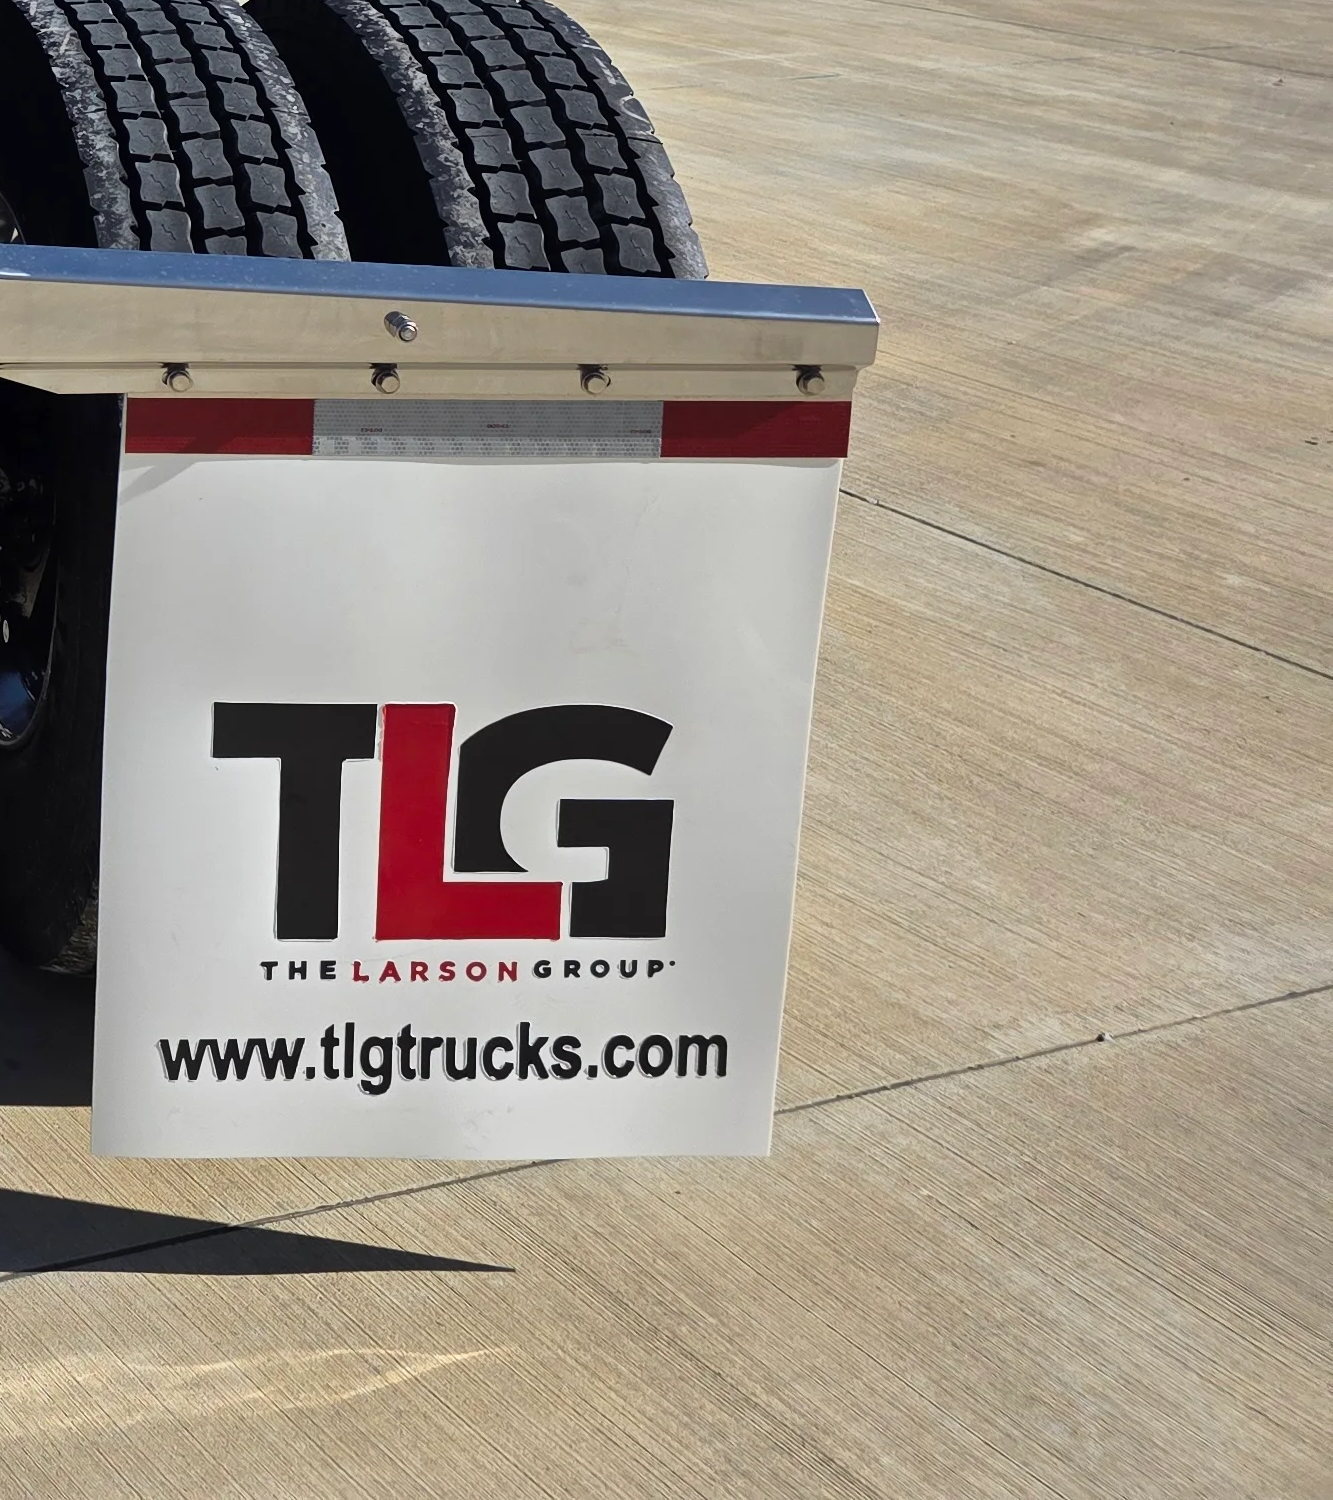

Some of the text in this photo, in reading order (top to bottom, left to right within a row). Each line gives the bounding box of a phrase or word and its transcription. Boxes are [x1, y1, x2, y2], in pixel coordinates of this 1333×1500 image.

[213, 702, 674, 940] TLG
[261, 960, 663, 982] THE LARSON GROUP
[160, 1022, 727, 1095] www.tlgtrucks.com
